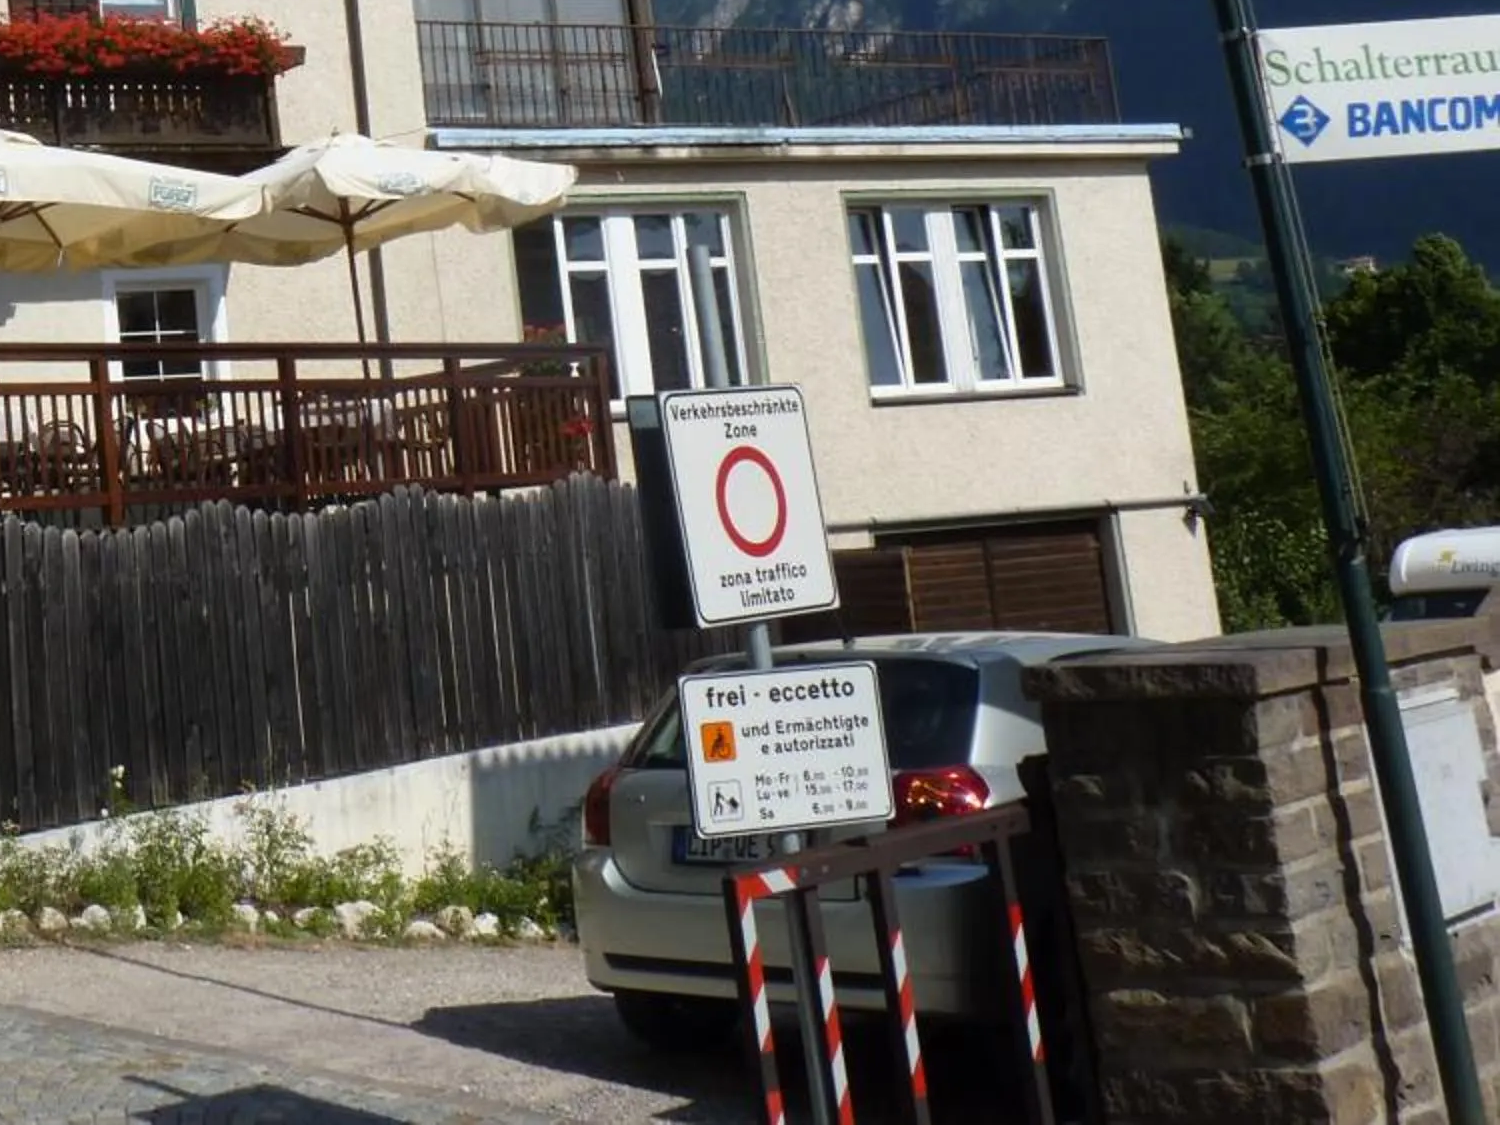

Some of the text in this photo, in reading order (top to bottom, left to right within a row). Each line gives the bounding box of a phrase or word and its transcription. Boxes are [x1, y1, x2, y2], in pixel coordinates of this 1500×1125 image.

[1265, 44, 1500, 86] Schalterrau
[1347, 94, 1500, 137] BANCOM
[669, 397, 799, 422] Verkehrsbeschränkte
[724, 422, 757, 439] Zone
[720, 562, 807, 588] zona traffico
[740, 586, 795, 608] limitato
[706, 684, 746, 709] frei
[769, 678, 855, 703] eccetto
[741, 713, 870, 739] und Ermächtigte
[760, 733, 855, 755] e autorizzati
[759, 806, 775, 820] Sa
